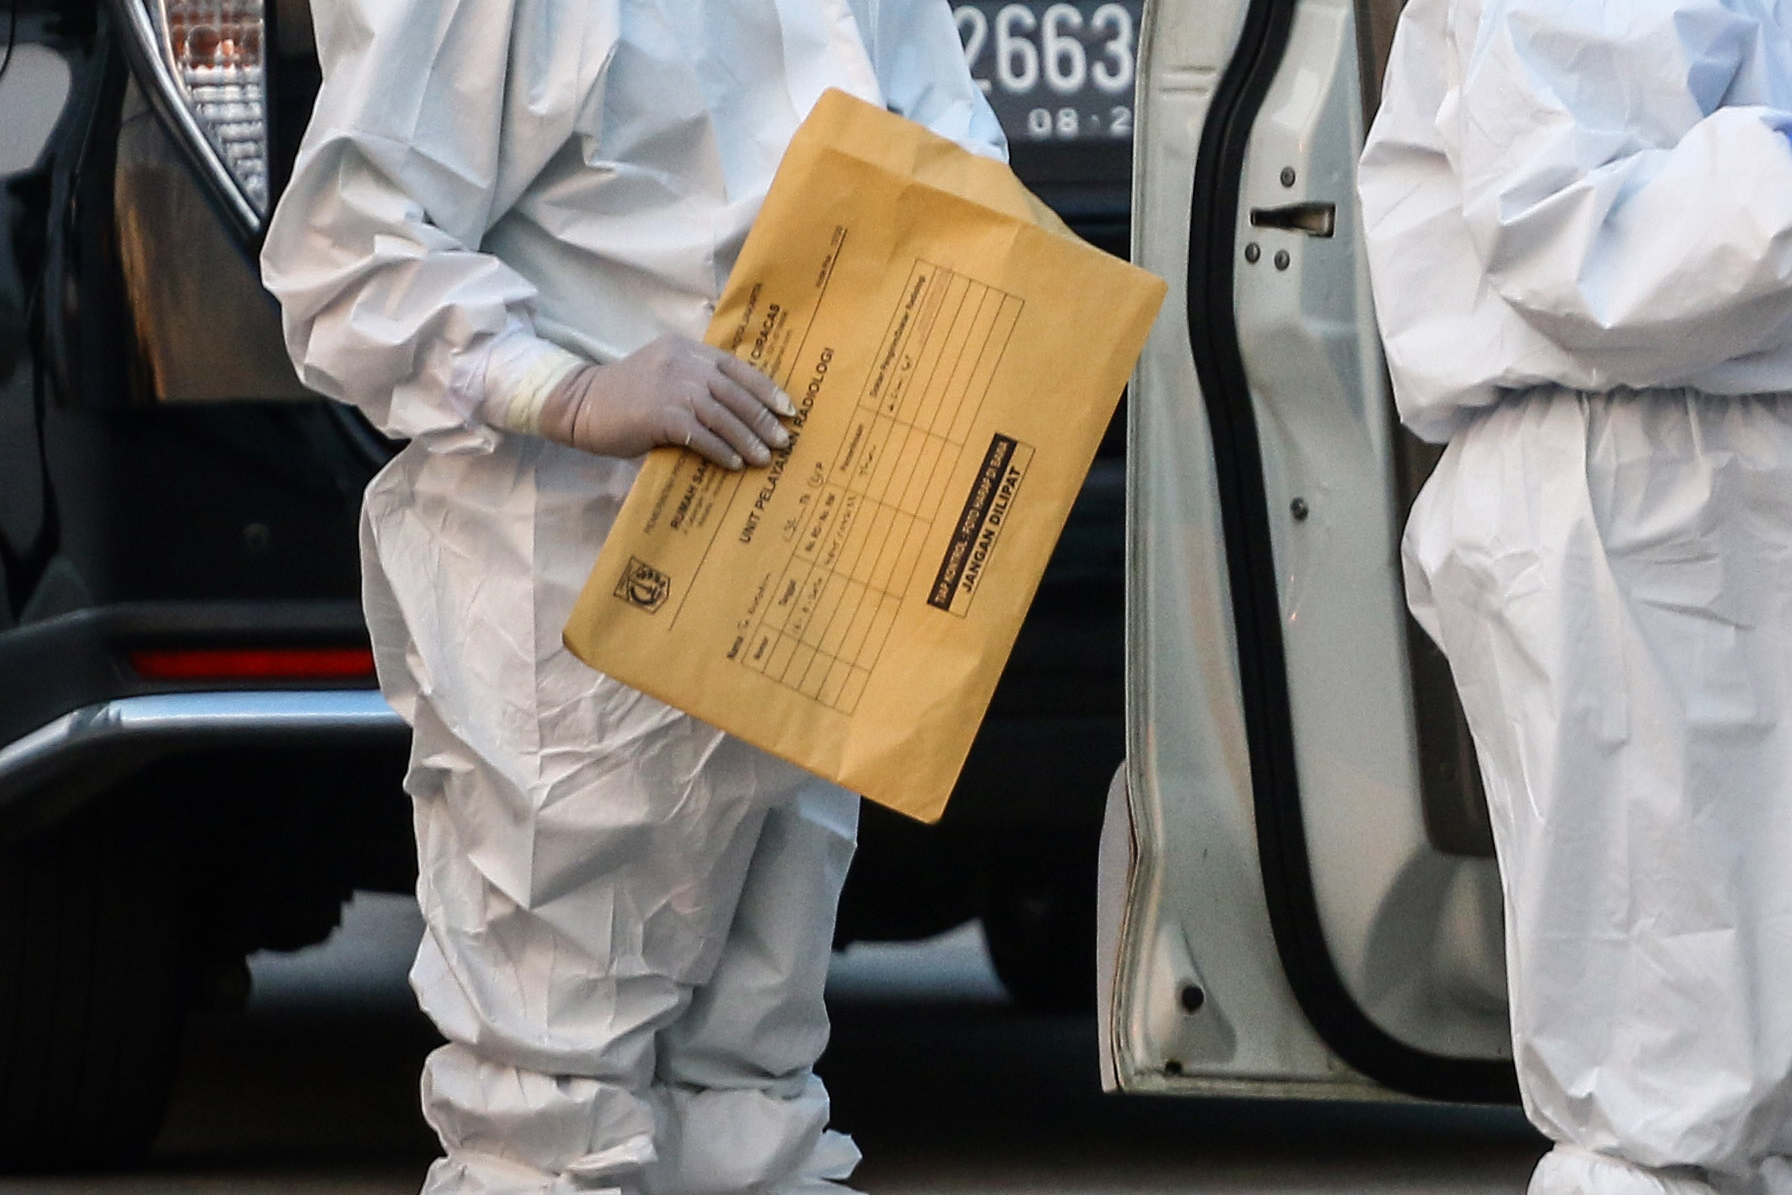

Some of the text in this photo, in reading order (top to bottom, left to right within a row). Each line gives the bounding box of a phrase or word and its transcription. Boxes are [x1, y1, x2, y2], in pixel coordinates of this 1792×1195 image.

[951, 2, 1135, 94] 2663
[668, 483, 698, 530] RUMAH
[748, 301, 781, 361] CIRACAS
[737, 510, 762, 545] UNIT
[792, 345, 836, 428] RADIOLOGI
[959, 464, 1022, 594] JANGAN DILIPAT
